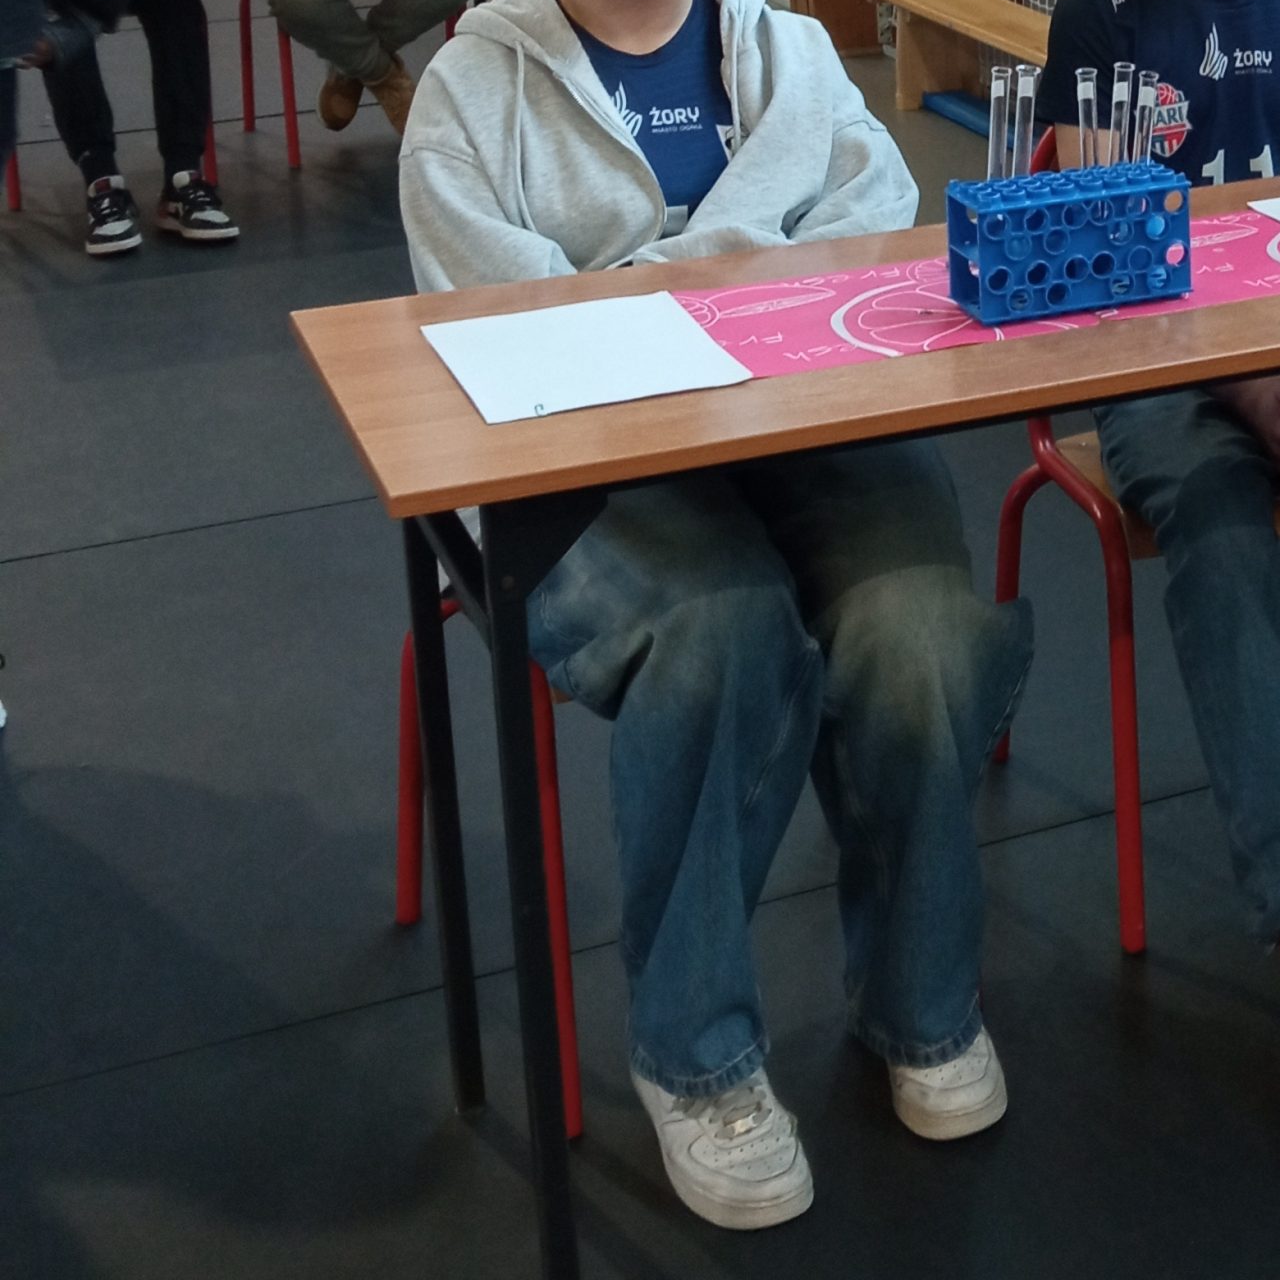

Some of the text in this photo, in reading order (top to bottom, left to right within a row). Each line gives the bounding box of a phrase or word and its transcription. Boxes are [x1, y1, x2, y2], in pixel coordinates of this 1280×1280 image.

[1233, 48, 1273, 67] ŻORY
[648, 106, 700, 126] ŻORY
[1151, 105, 1185, 127] ARI
